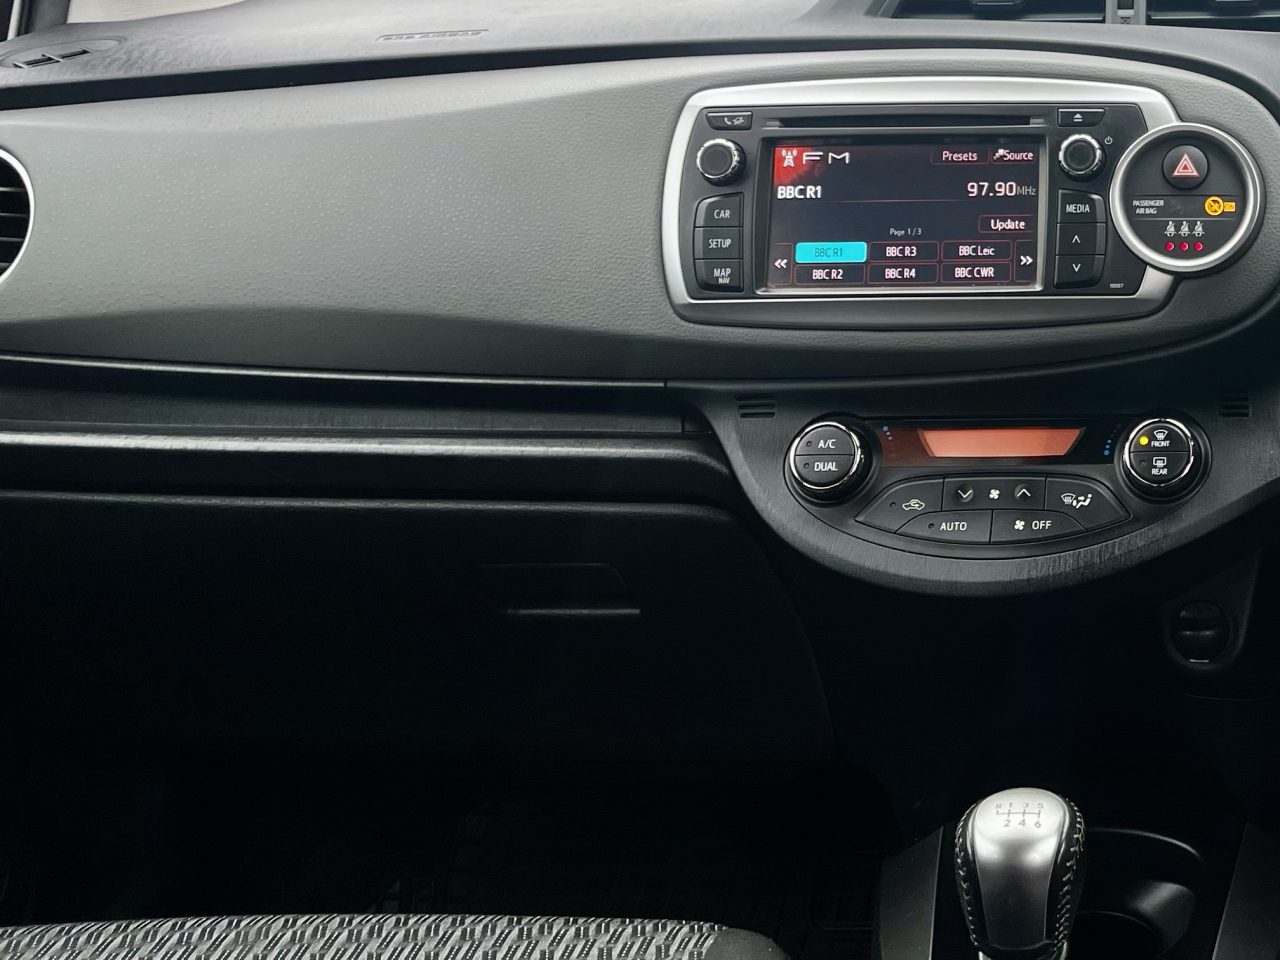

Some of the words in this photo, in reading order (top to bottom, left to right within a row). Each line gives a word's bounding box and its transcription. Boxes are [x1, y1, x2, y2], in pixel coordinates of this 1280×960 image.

[802, 151, 851, 166] FM
[942, 150, 978, 162] Presets
[1003, 149, 1034, 161] Source
[777, 185, 804, 200] BBC
[806, 185, 822, 200] R1
[967, 181, 1016, 197] 97.90
[1066, 203, 1091, 214] MEDIA
[1132, 199, 1165, 207] PASSENGER
[713, 209, 731, 219] CAR
[990, 218, 1026, 231] Update
[889, 227, 905, 237] Page
[708, 238, 732, 249] SETUP
[814, 247, 831, 258] BBC
[832, 247, 844, 258] R1
[886, 246, 903, 257] BBC
[904, 246, 917, 257] R3
[958, 245, 976, 256] BBC
[978, 245, 995, 256] Leic
[713, 267, 732, 278] MAP
[812, 268, 830, 280] BBC
[831, 268, 843, 280] R2
[884, 267, 903, 279] BBC
[904, 267, 916, 279] R4
[955, 266, 972, 278] BBC
[974, 266, 995, 278] CWR
[817, 439, 837, 449] A/C
[814, 461, 838, 471] DUAL
[1151, 468, 1168, 476] REAR
[939, 521, 967, 531] AUTO
[1031, 520, 1053, 530] OFF
[1003, 819, 1012, 828] 2
